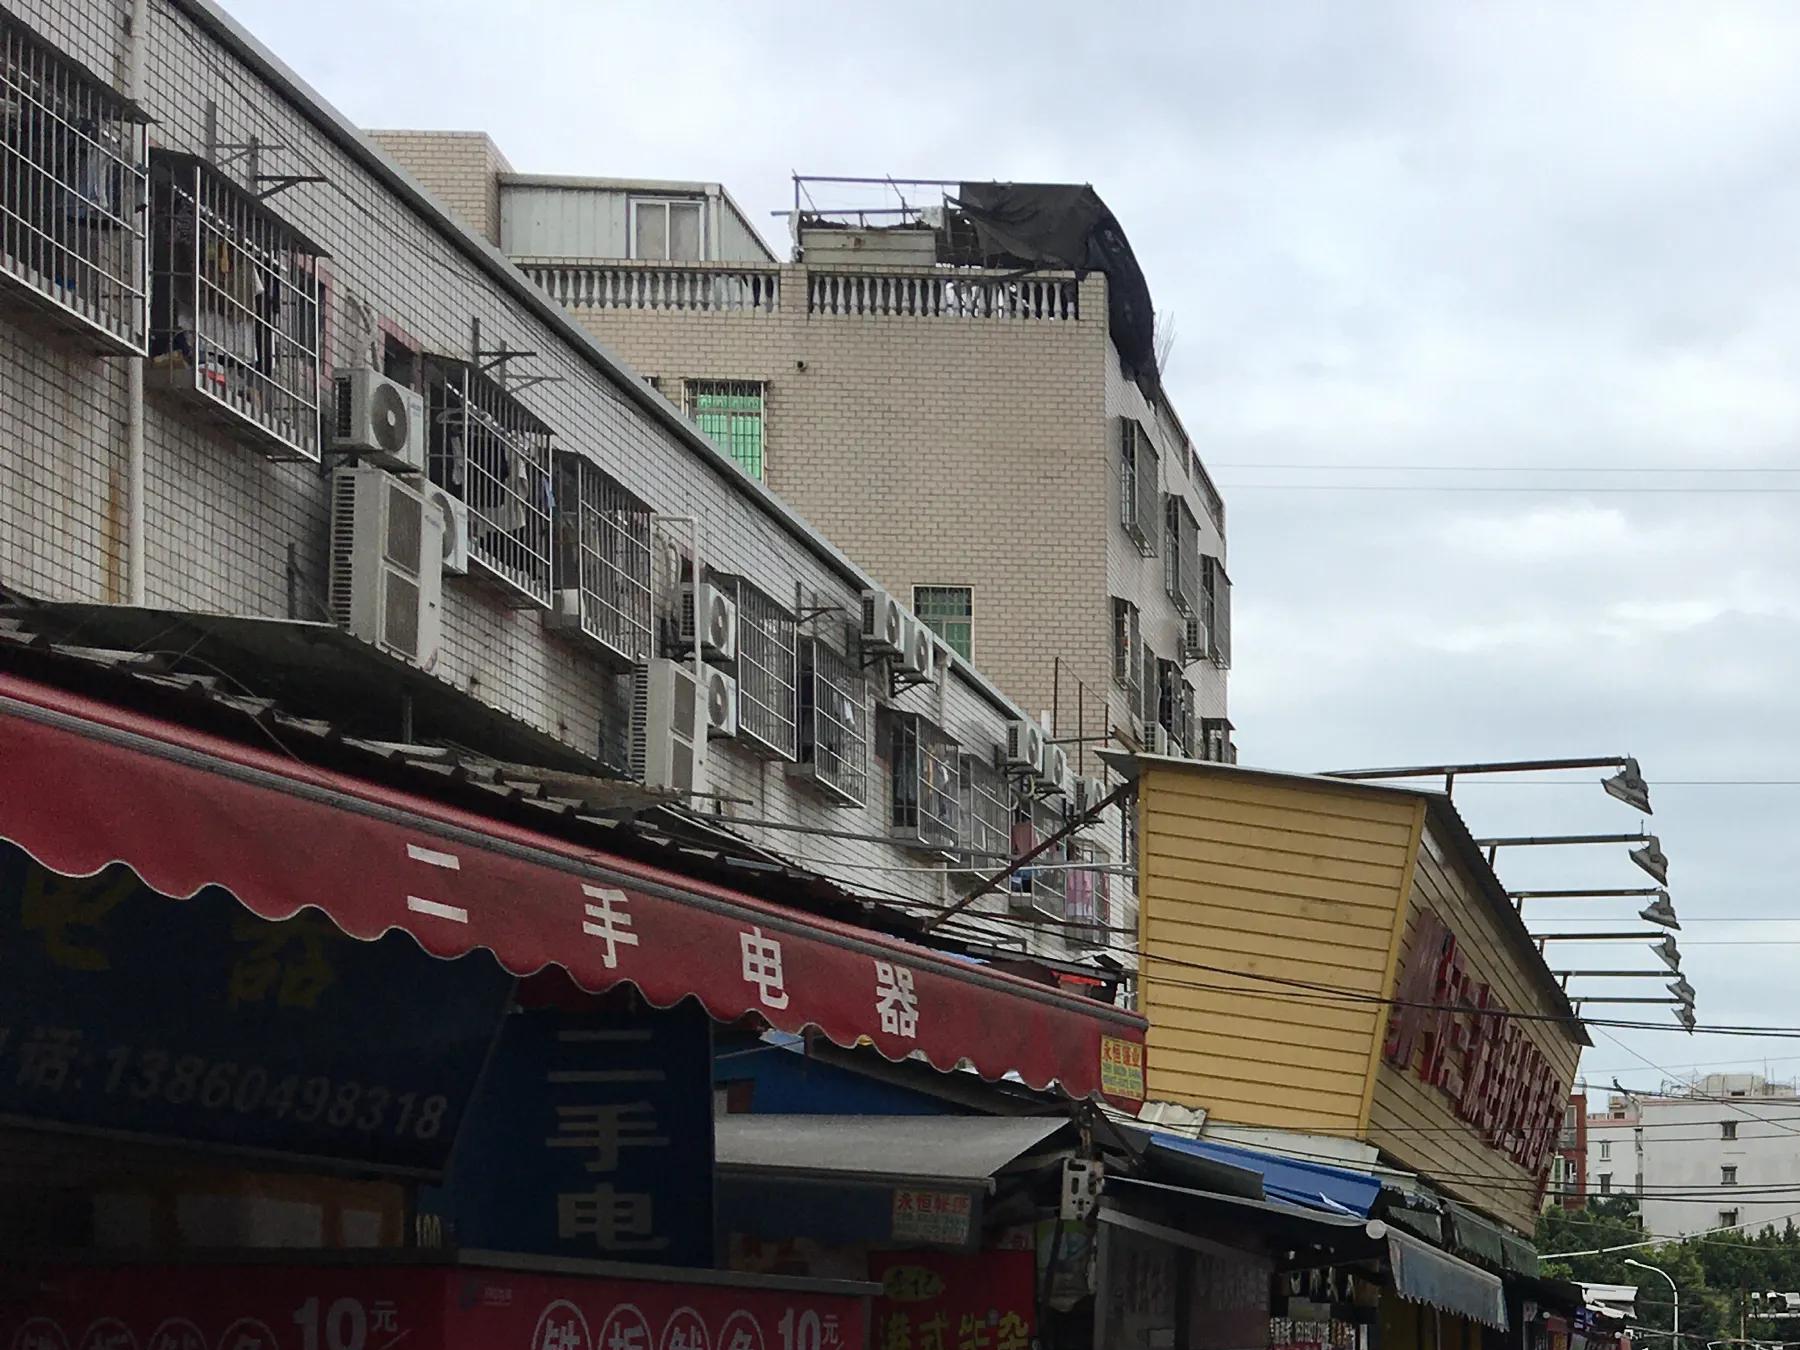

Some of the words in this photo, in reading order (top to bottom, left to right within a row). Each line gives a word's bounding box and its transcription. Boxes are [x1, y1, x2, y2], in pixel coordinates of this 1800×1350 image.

[407, 843, 920, 1039] 二手电器
[546, 1030, 671, 1251] 二手电
